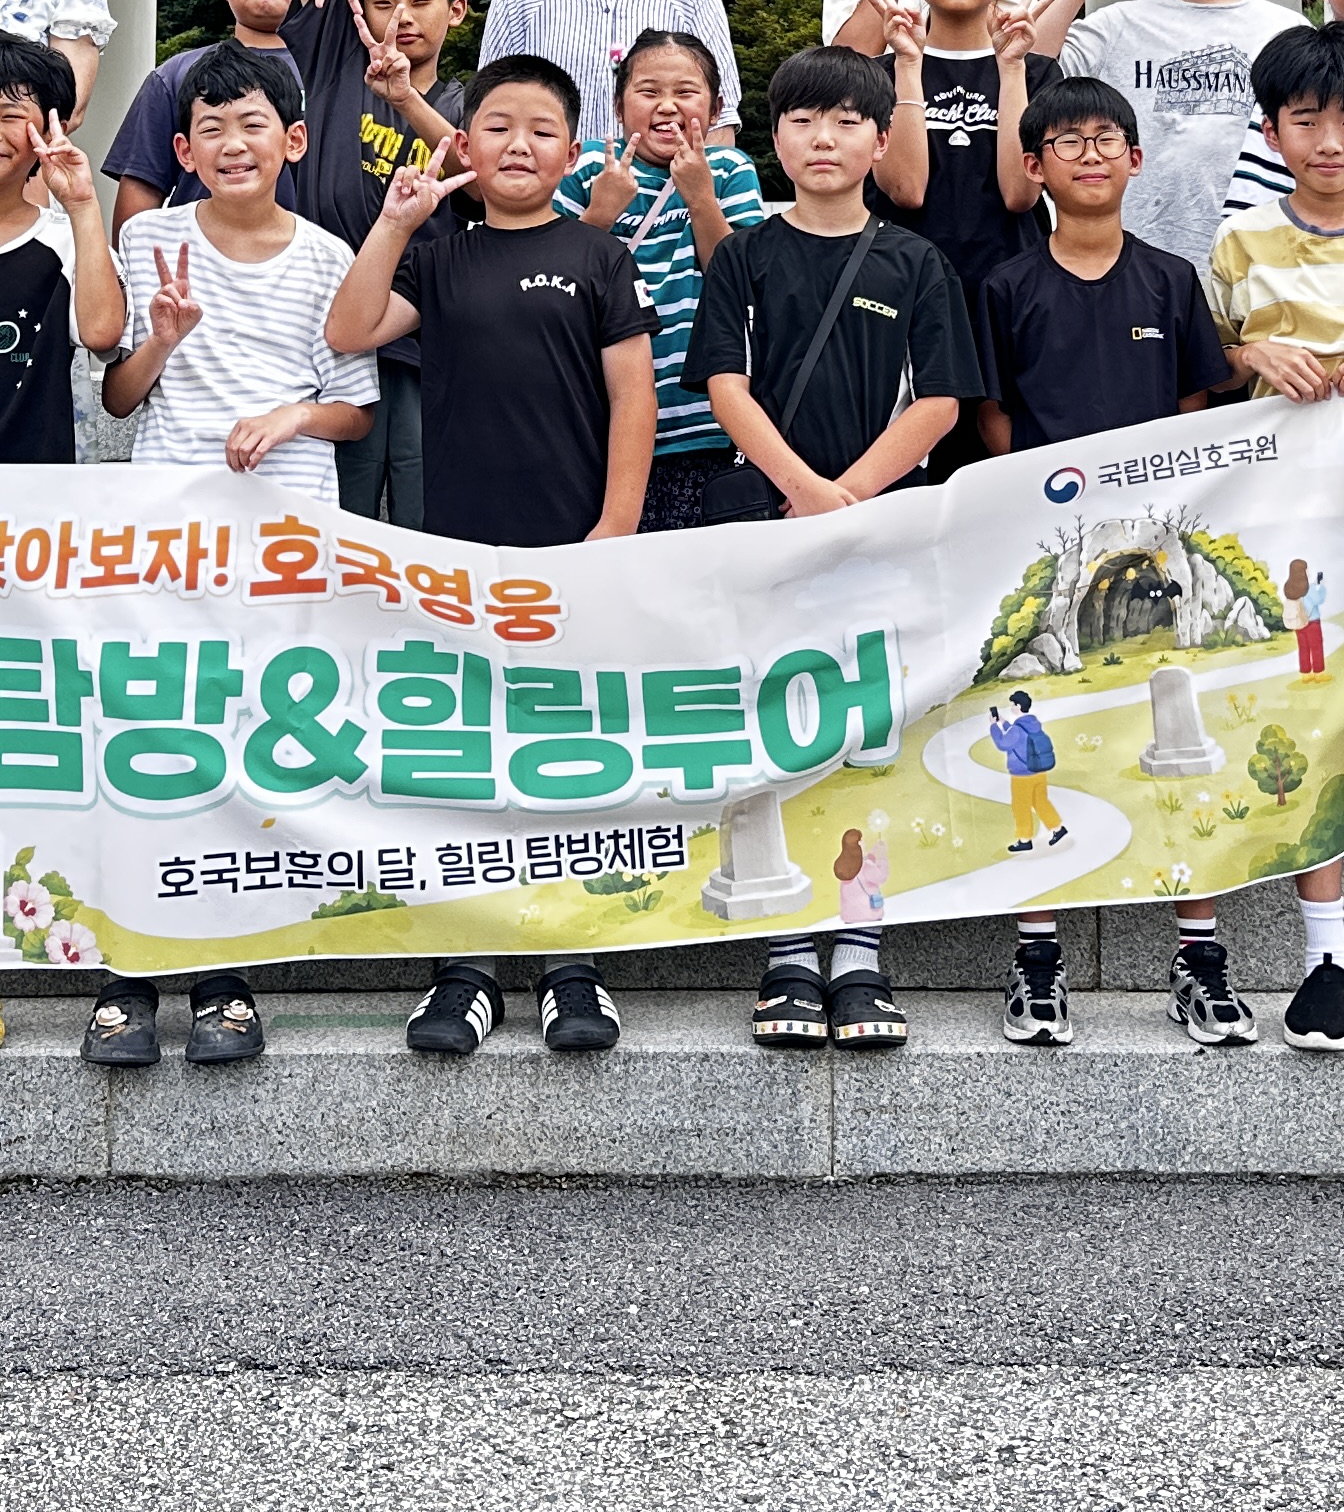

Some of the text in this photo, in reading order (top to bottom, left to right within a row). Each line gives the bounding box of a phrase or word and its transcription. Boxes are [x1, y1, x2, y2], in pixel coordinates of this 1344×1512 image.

[924, 101, 1000, 124] acht Clu
[1097, 433, 1279, 488] 국립임실호국원
[248, 514, 562, 642] 호국영웅
[156, 825, 686, 899] 호국보훈의 달, 힐링 탐방체험
